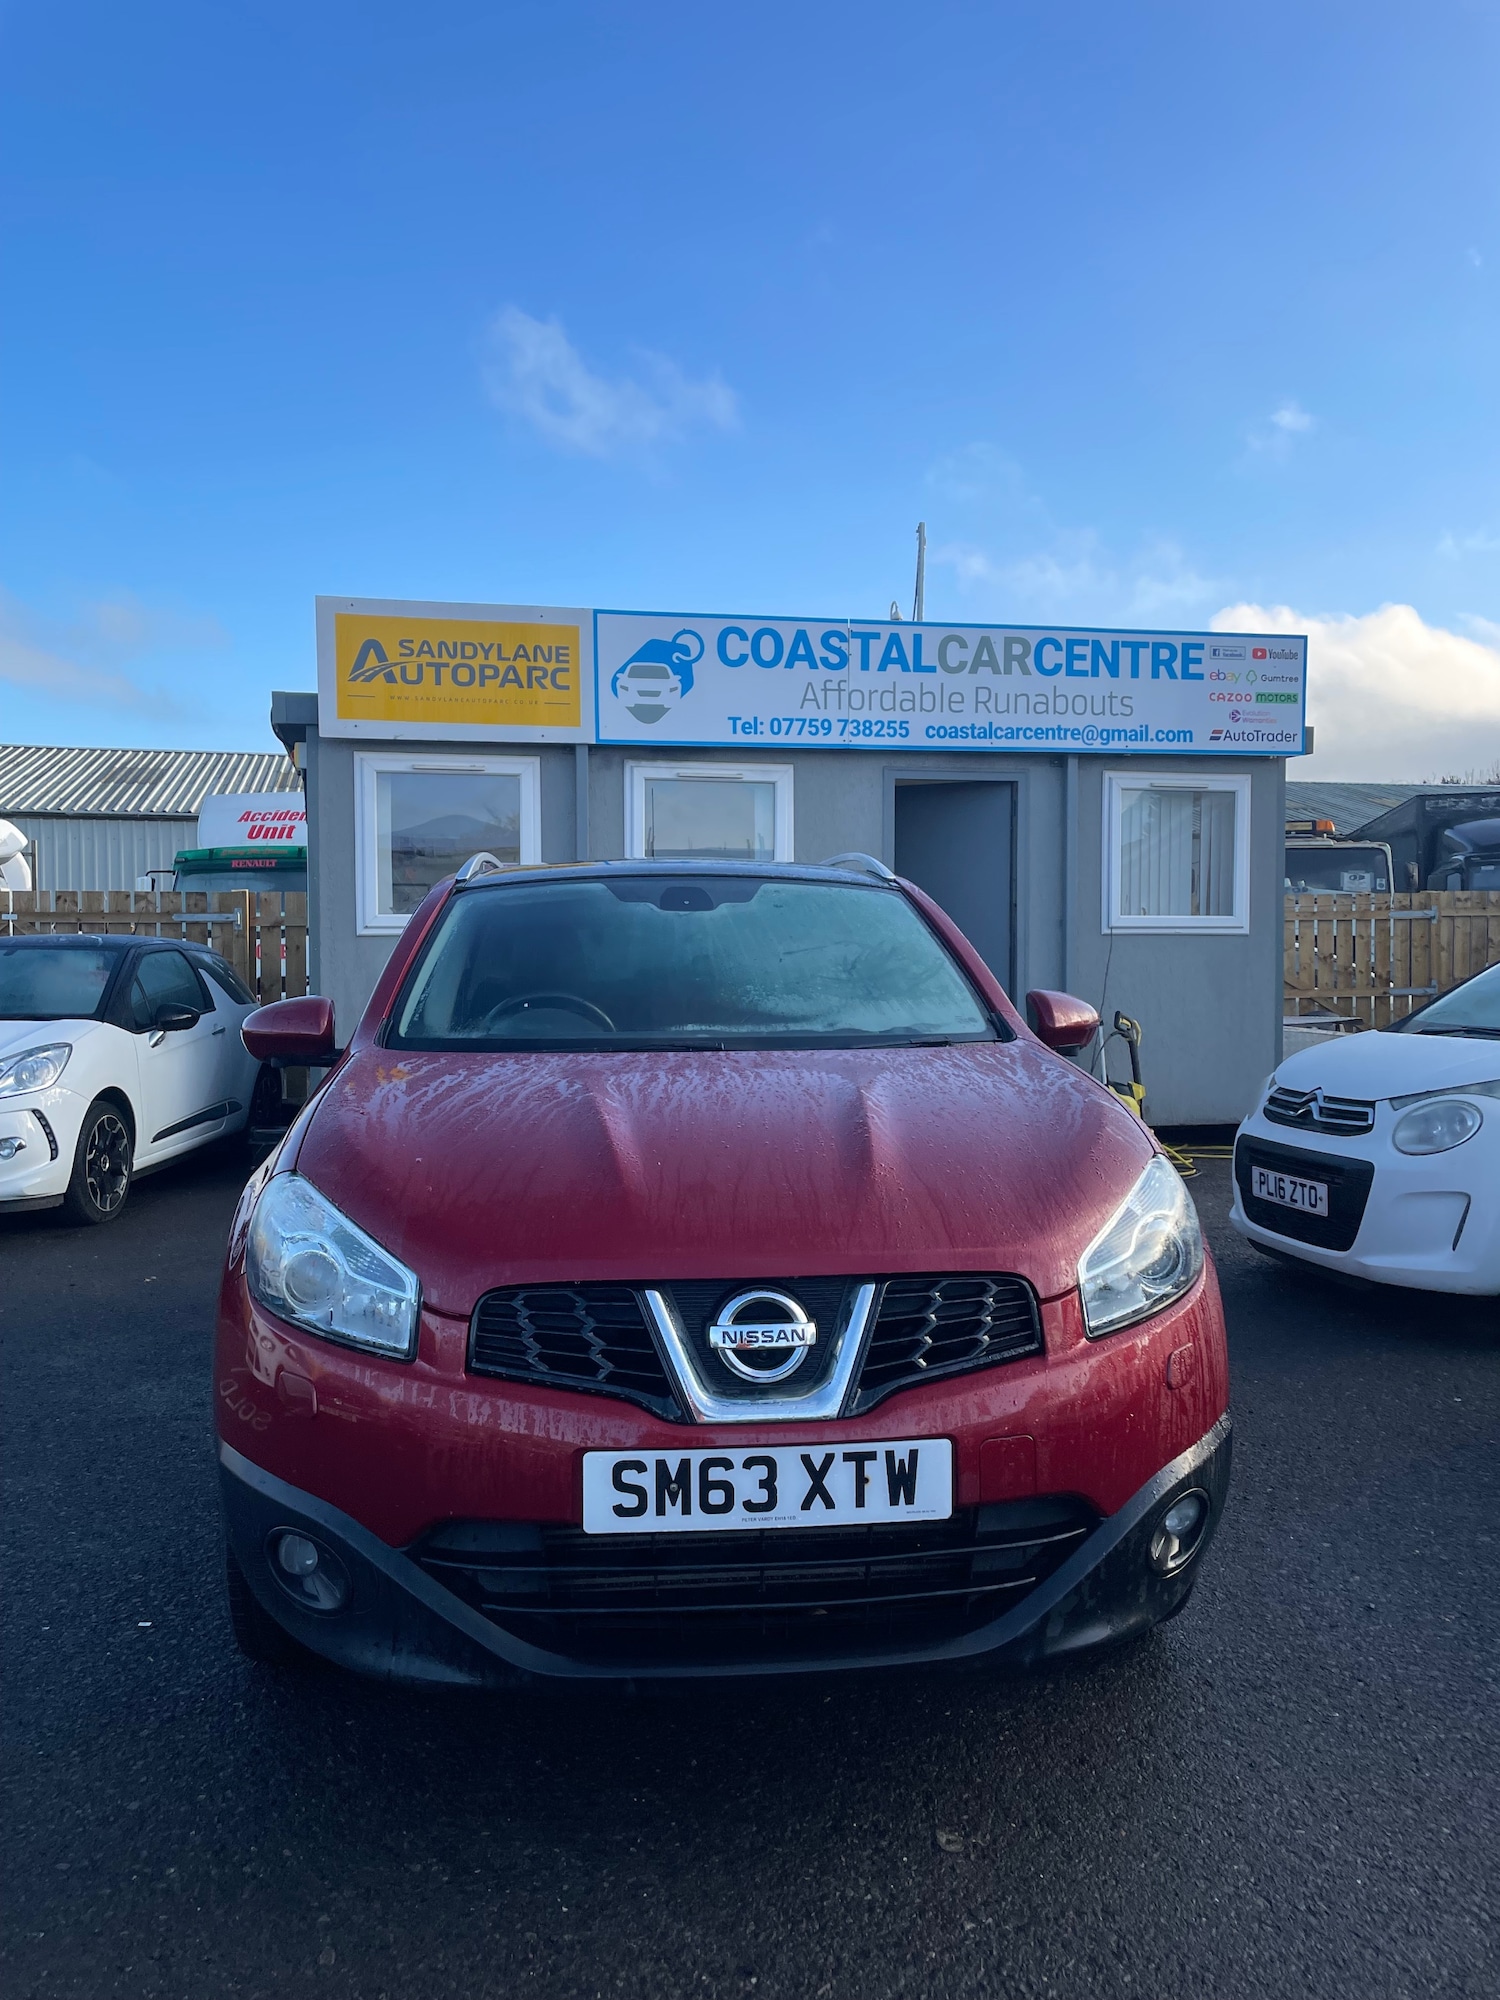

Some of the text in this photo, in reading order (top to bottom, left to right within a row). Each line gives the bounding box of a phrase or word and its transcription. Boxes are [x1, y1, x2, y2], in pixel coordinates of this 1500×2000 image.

[398, 639, 570, 664] SANDYLANE
[1268, 649, 1299, 660] YouTube
[347, 638, 571, 691] AUTOPARC
[1209, 669, 1242, 685] ebay
[1260, 674, 1299, 683] Gumtree
[799, 679, 1134, 717] Affordable Runabouts
[1209, 692, 1253, 703] CAZOO
[727, 716, 1194, 746] Tel: 07759 738255 coastalcarcentre@gmail.com
[1223, 729, 1298, 742] AutoTrader
[247, 824, 296, 839] Unit
[231, 859, 277, 868] RENAULT
[1258, 1171, 1286, 1200] PL16
[722, 1328, 805, 1344] NISSAN
[611, 1448, 920, 1518] SM63 XTW
